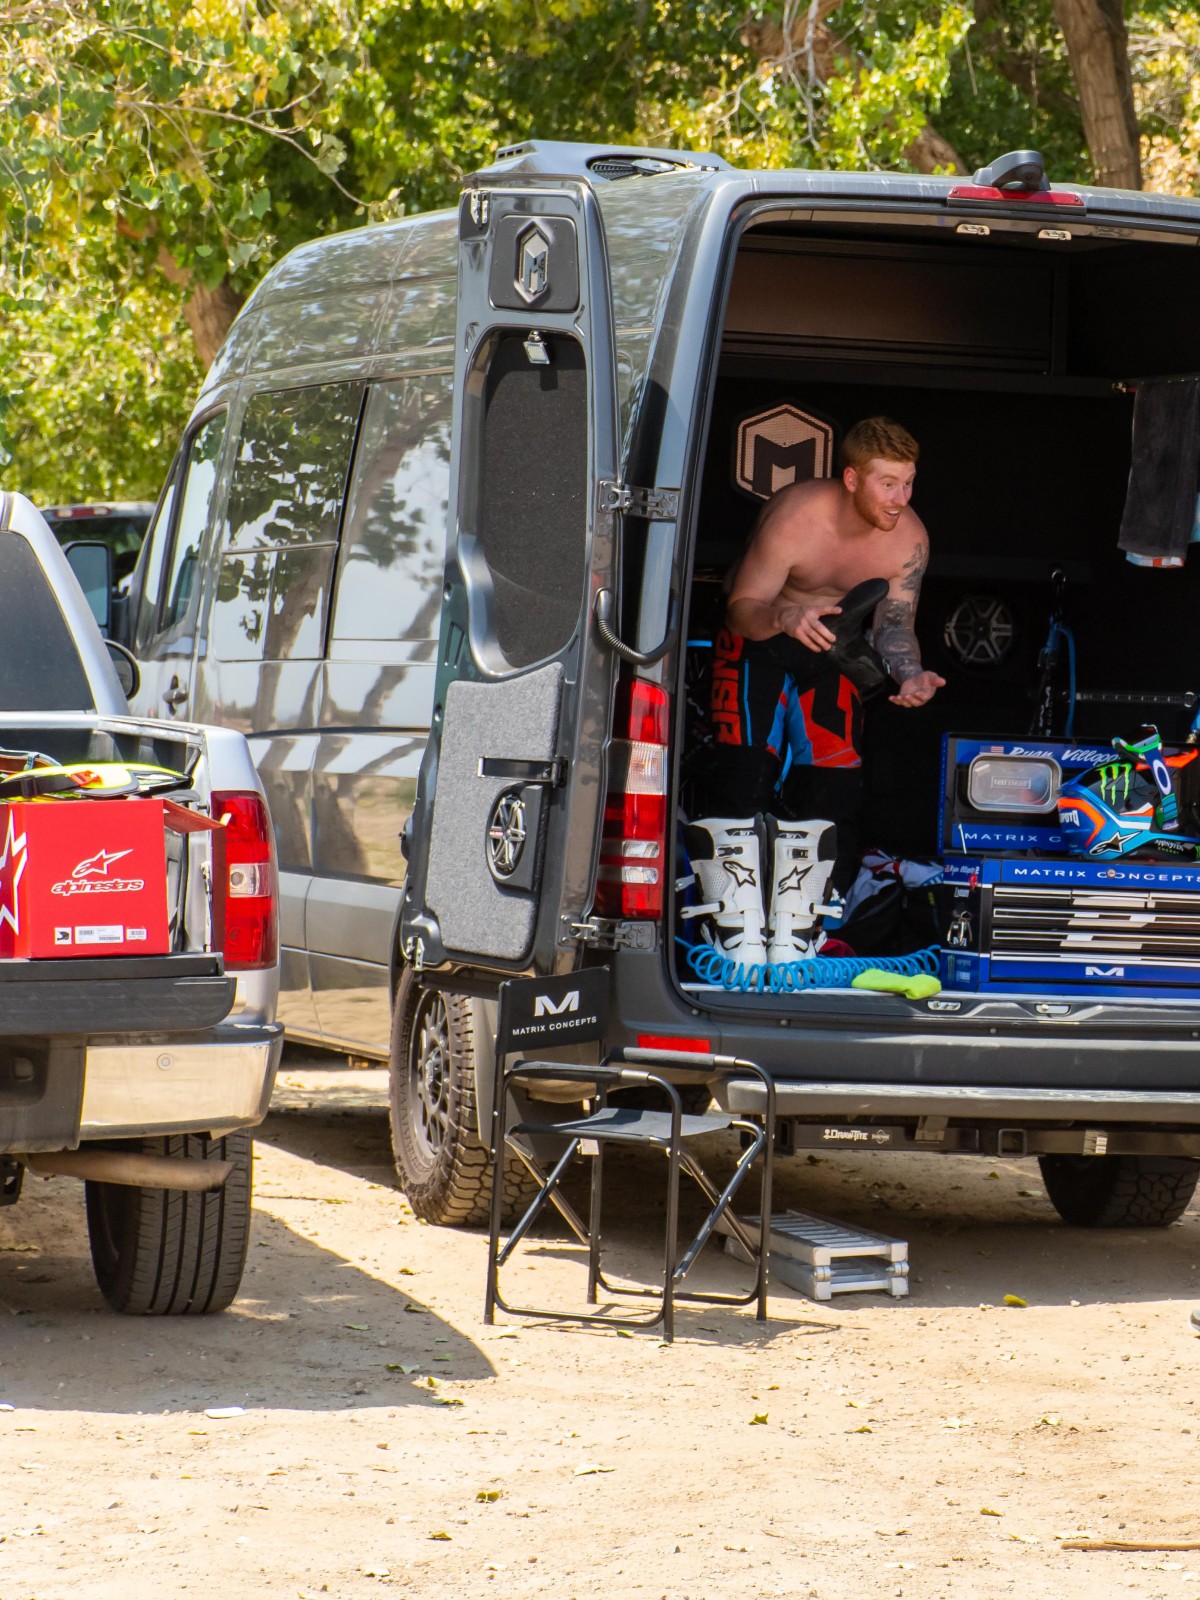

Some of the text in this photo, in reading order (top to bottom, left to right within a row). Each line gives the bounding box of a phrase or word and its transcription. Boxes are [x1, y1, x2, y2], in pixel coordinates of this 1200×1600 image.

[964, 832, 1038, 843] MATRIX
[1014, 868, 1086, 879] MATRIX
[51, 879, 145, 896] alpinestars
[512, 1016, 597, 1036] MATRIX CONCEPTS
